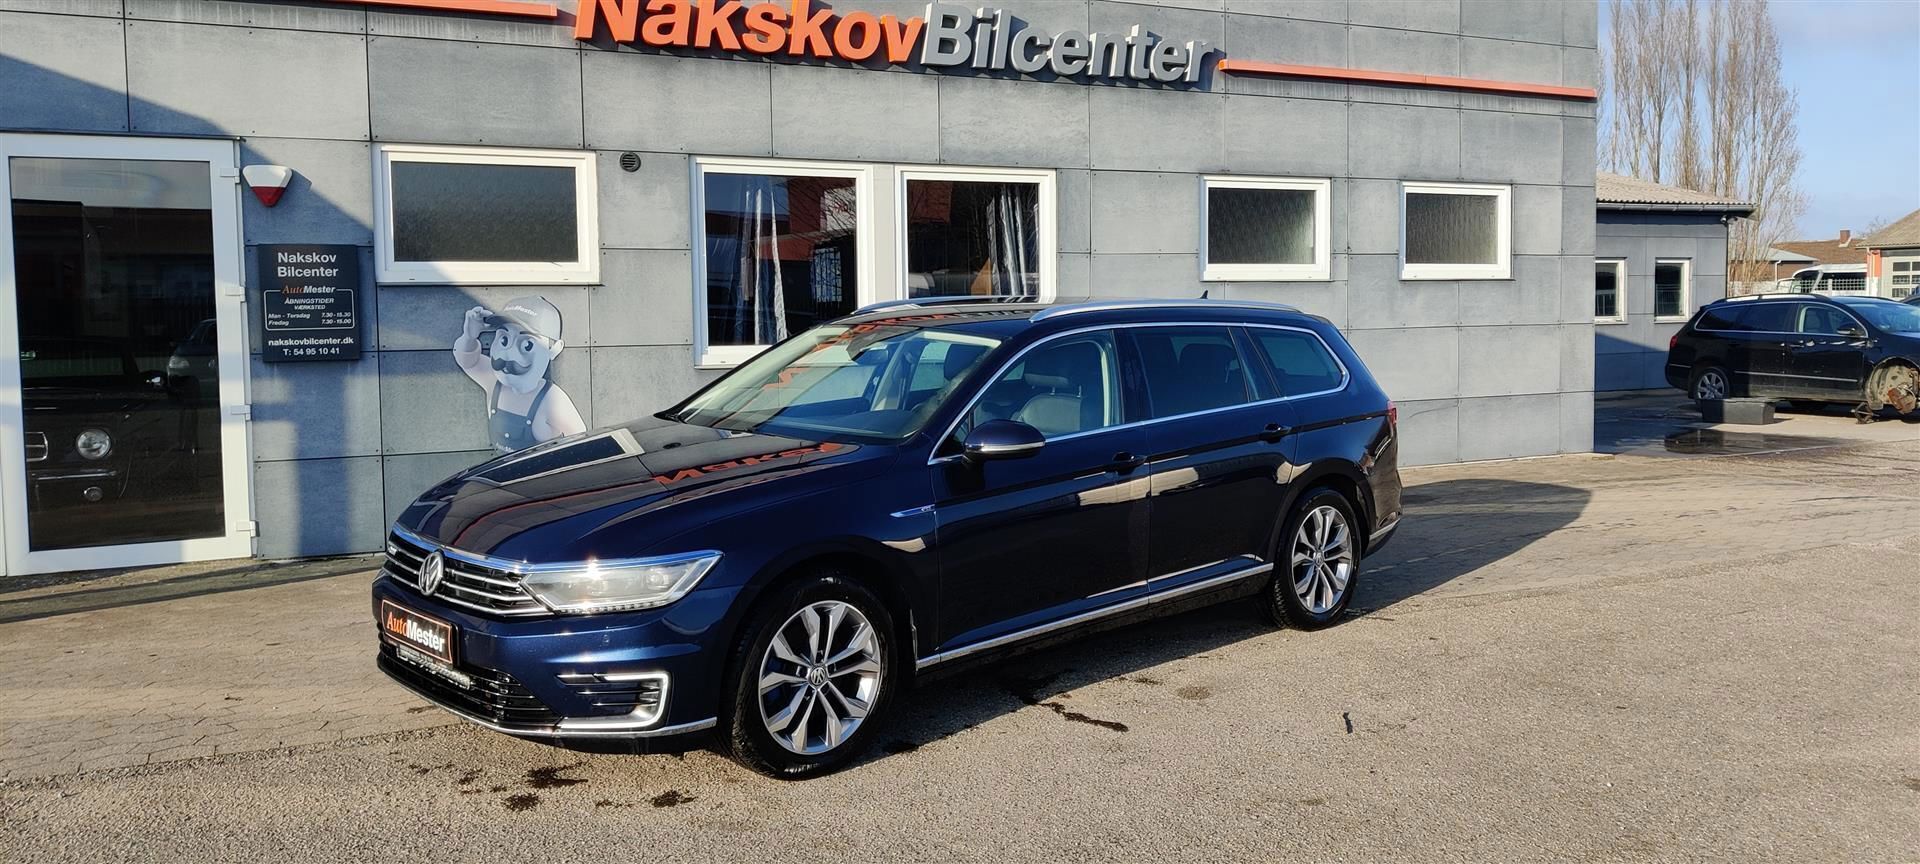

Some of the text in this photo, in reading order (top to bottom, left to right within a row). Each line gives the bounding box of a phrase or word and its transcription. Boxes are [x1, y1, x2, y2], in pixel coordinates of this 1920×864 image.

[277, 252, 337, 263] Nakskov
[277, 266, 339, 277] Bilcenter
[281, 285, 336, 294] AutoMester
[284, 297, 335, 305] ÅBNINGSTIDER
[268, 336, 354, 346] nakskovbilcenter.dk
[282, 347, 340, 356] T: 54 95 10 41
[386, 611, 445, 653] AutoMester
